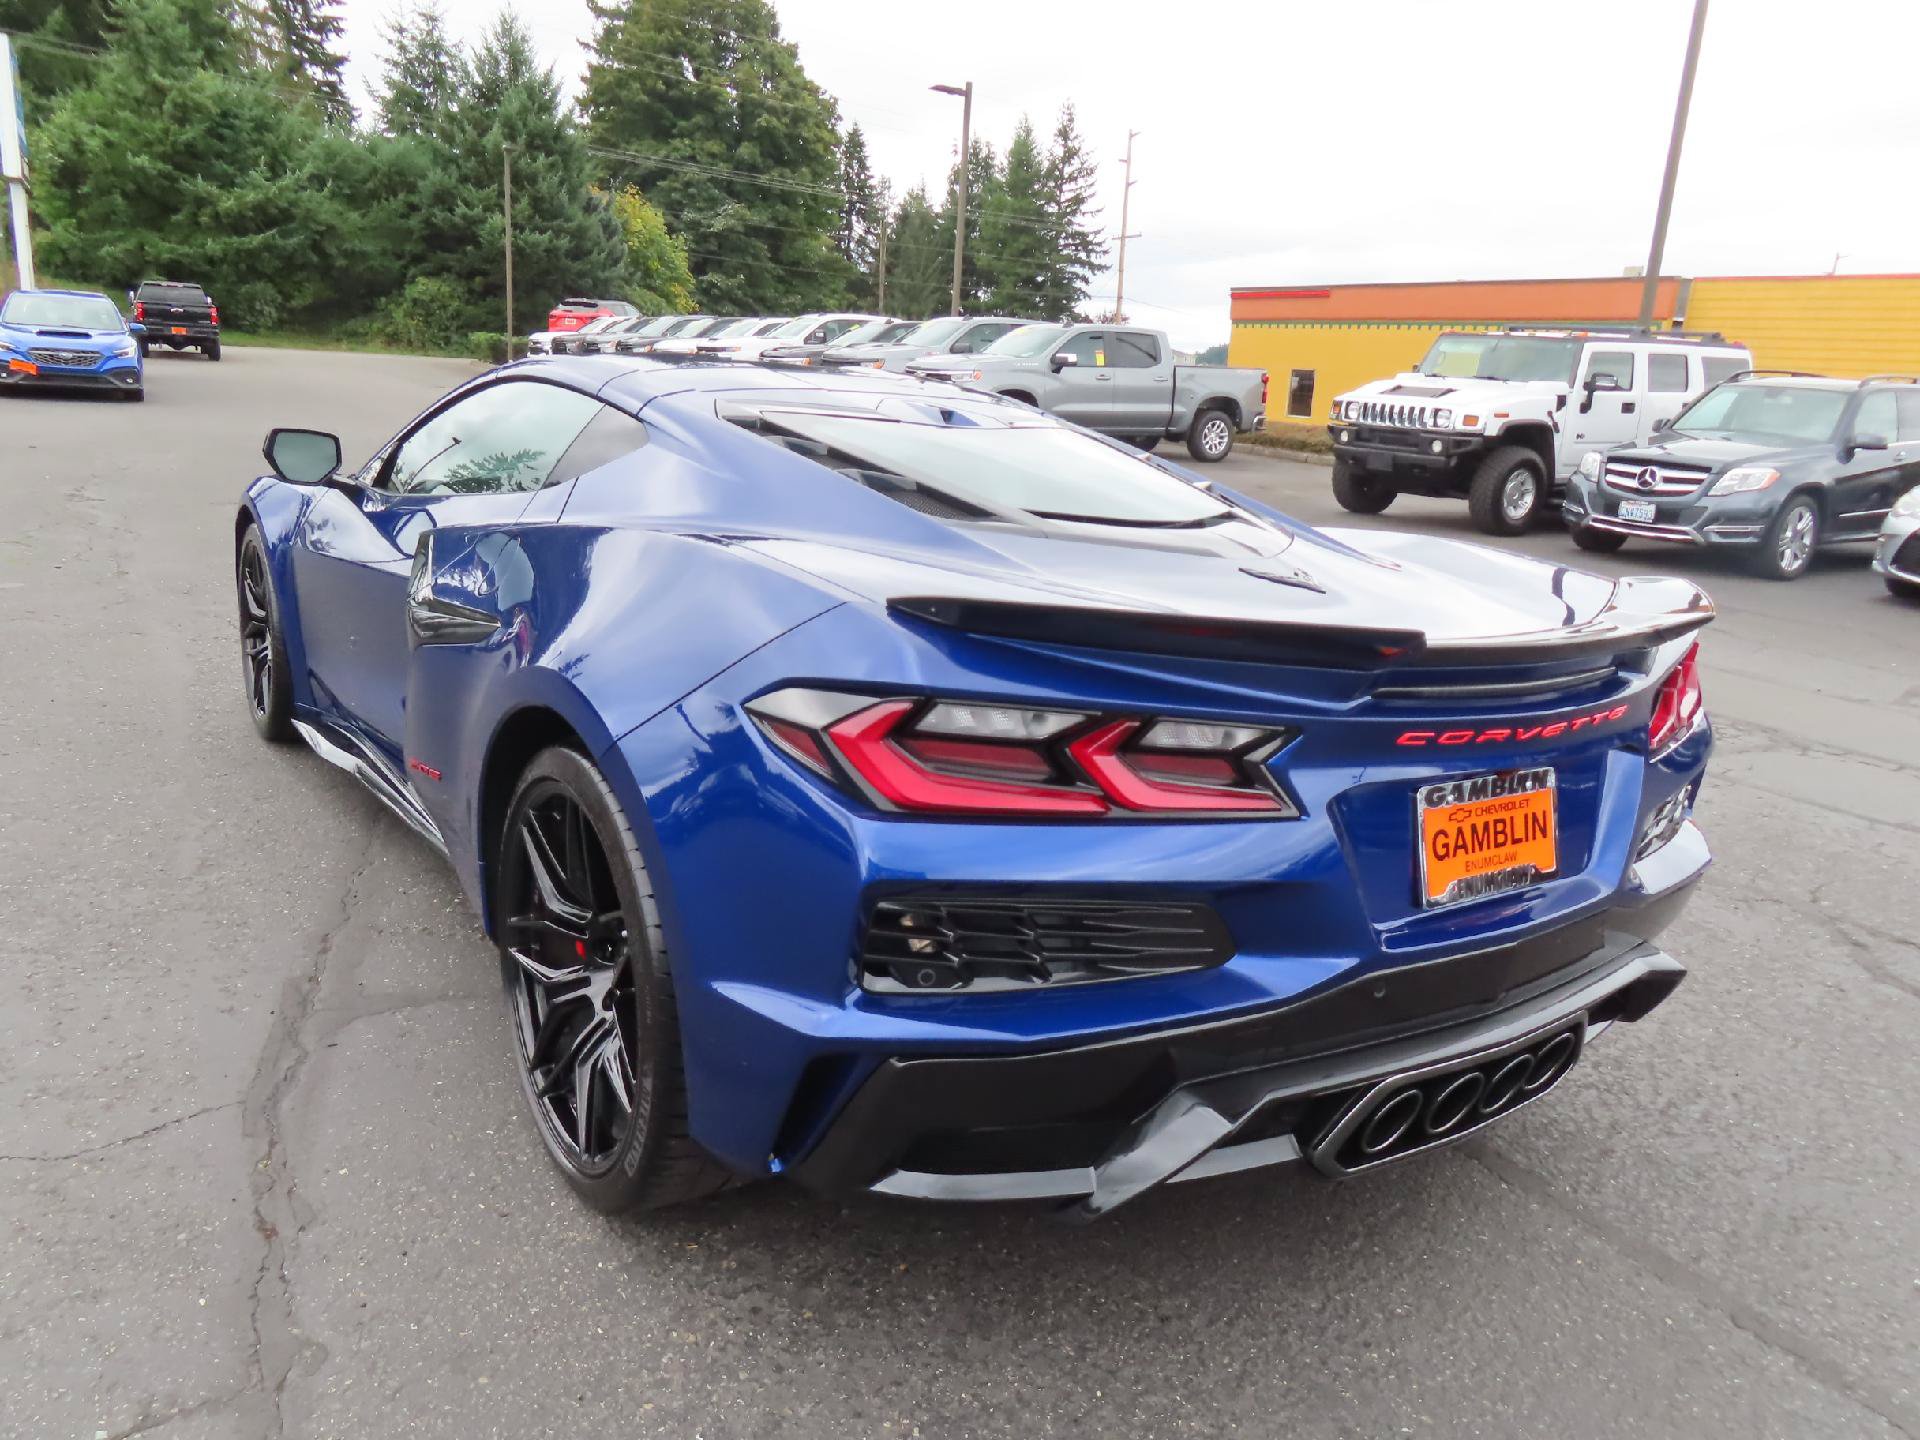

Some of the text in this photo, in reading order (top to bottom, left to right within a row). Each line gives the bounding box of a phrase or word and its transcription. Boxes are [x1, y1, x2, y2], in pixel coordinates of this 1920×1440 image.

[1396, 704, 1628, 746] CORVETTE
[1475, 798, 1531, 817] CHEVROLET
[1432, 810, 1547, 862] GAMBLIN
[1464, 850, 1518, 873] ENUMCLAW
